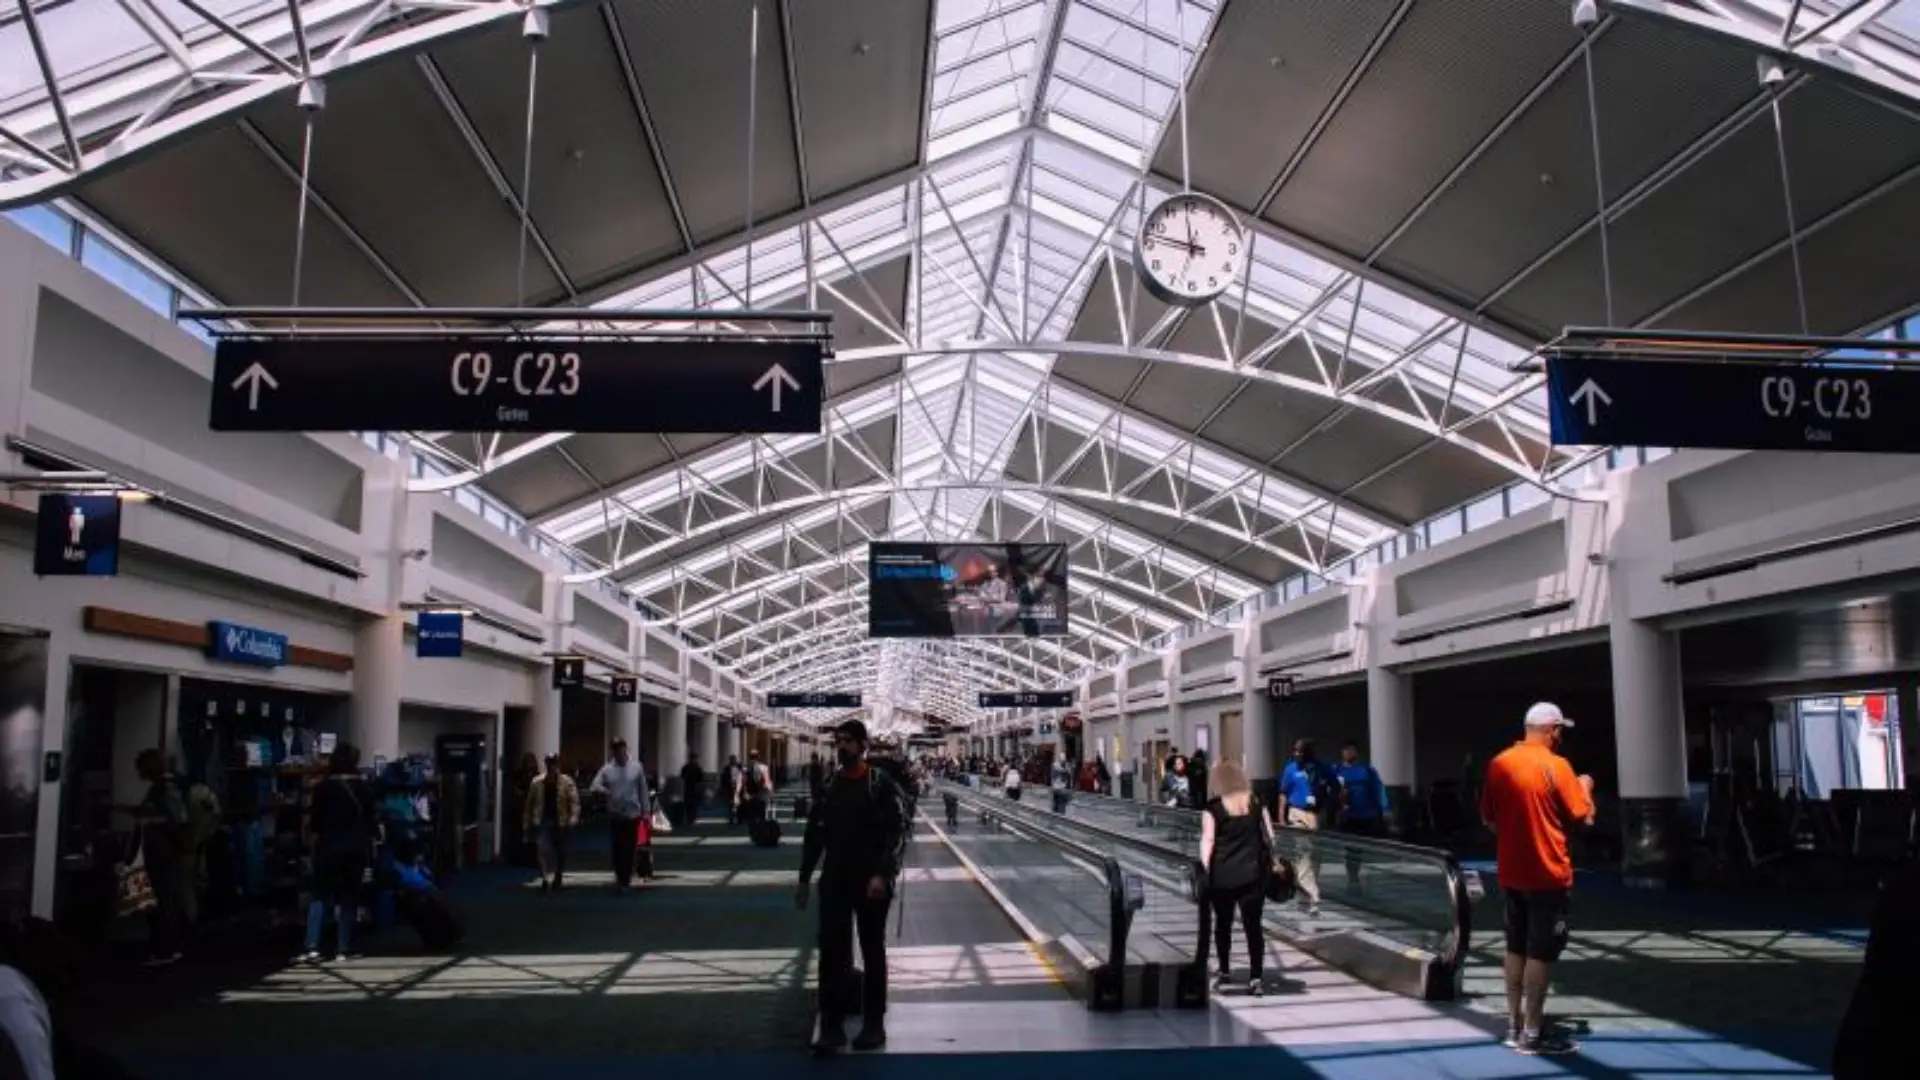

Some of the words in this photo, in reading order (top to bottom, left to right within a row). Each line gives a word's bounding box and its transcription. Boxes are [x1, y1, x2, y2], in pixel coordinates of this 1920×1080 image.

[1228, 242, 1238, 256] 3
[451, 352, 580, 396] C9-C23
[1761, 376, 1871, 419] C9-C23
